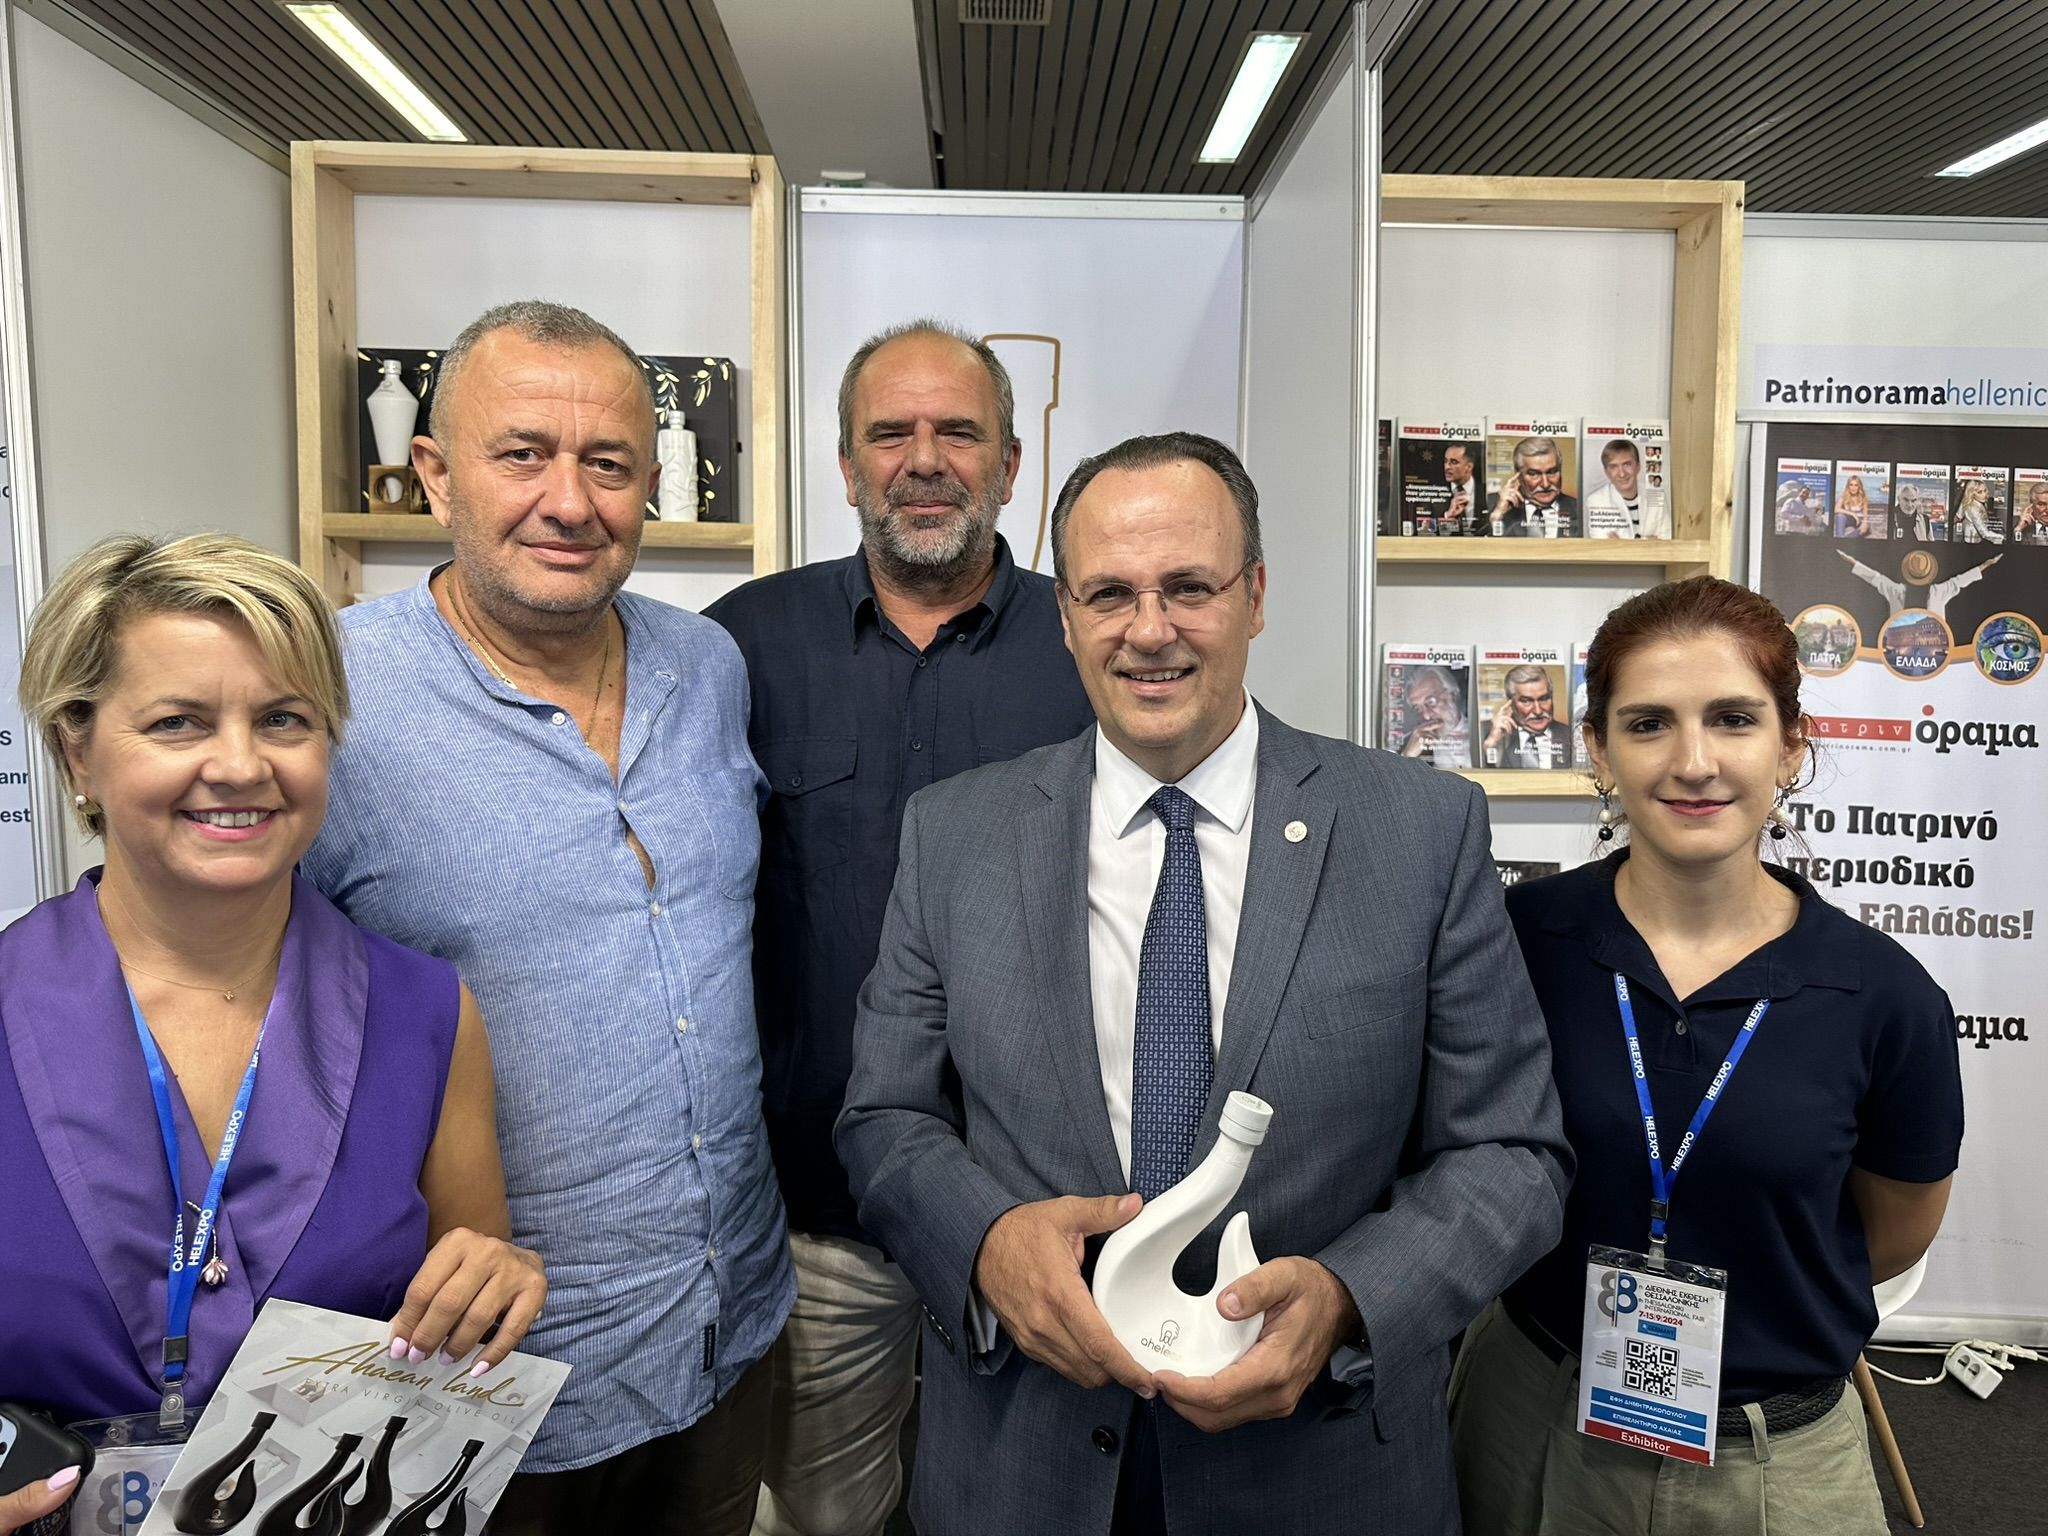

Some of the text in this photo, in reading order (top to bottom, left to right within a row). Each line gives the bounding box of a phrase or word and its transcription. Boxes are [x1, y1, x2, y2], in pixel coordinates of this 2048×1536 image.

[1809, 651, 1841, 665] ΠΑΤΡΑ
[1896, 655, 1937, 669] ΕΛΛΑΔΑ
[1990, 660, 2030, 673] ΚΟΣΜΟΣ
[1819, 721, 1904, 737] ατριν
[1788, 802, 1998, 842] Το Πατρινό
[1786, 855, 1975, 888] περιοδικό
[1956, 1013, 2028, 1049] αμα
[1629, 1036, 1645, 1079] HELEXPO
[1705, 1061, 1732, 1101] HELEXPO
[219, 1109, 243, 1162] HELEXPO
[1645, 1116, 1660, 1160] HELEXPO
[1671, 1131, 1695, 1171] HELEXPO
[187, 1208, 213, 1267] HELEXPO
[363, 1388, 422, 1408] VIRGIN
[435, 1402, 481, 1418] OLIVE
[491, 1412, 517, 1425] OIL
[1621, 1431, 1671, 1452] Exhibitor
